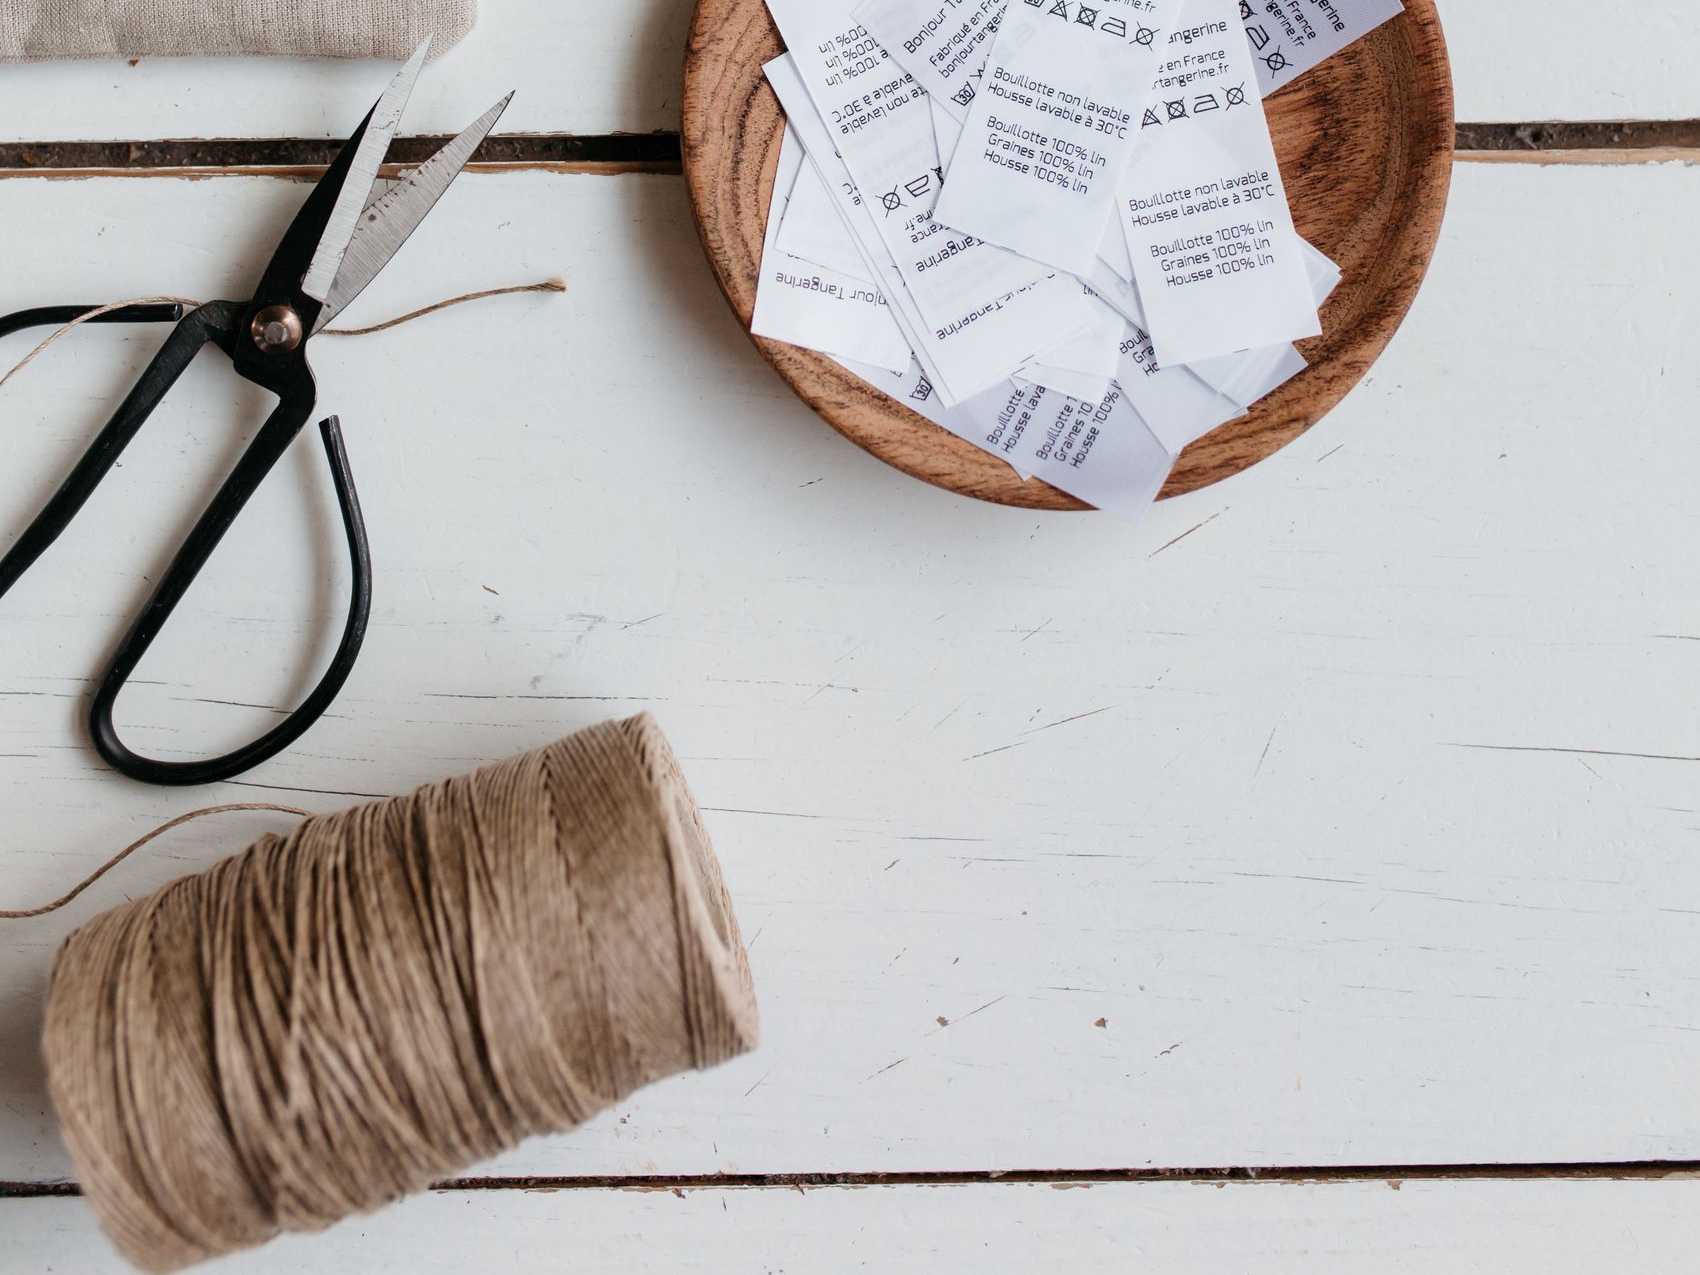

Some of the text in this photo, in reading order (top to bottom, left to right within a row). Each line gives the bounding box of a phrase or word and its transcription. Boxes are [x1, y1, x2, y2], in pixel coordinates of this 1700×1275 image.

[819, 25, 867, 53] 00% lin
[903, 8, 947, 53] Bonjour
[929, 23, 972, 67] Fabriqué
[970, 11, 985, 26] en
[1168, 21, 1228, 44] ngerine
[1287, 0, 1316, 40] France
[826, 56, 842, 68] lin
[842, 38, 879, 61] 100%
[939, 5, 1007, 79] bonjourtangeri
[1167, 60, 1181, 71] en
[1184, 50, 1225, 66] France
[826, 56, 880, 86] 100% lin
[873, 73, 914, 99] avable
[1152, 62, 1229, 90] rtangerine.fr
[832, 100, 862, 123] 30°C
[840, 94, 909, 134] non lavable
[863, 95, 872, 106] à
[988, 82, 1127, 139] Housse lavable à 30°C
[994, 67, 1130, 124] Bouillotte non lavable
[987, 116, 1106, 167] Bouillotte 100% lin
[988, 134, 1094, 179] Graines 100% lin
[984, 149, 1088, 194] Housse 100% lin
[1129, 171, 1269, 211] Bouillotte non lavable
[1132, 185, 1275, 227] Housse lavable à 30°C
[911, 224, 950, 243] rance
[1150, 220, 1274, 257] Bouillotte 100% lin
[1161, 238, 1271, 272] Graines 100% lin
[1166, 254, 1274, 287] Housse 100% lin
[776, 272, 888, 307] njour Tangerine
[1119, 329, 1148, 354] Bouil
[987, 389, 1024, 445] Bouillotte
[1002, 385, 1046, 453] Housse lava
[1036, 404, 1073, 460] Bouillotte
[1054, 419, 1084, 462] Graines
[1078, 402, 1093, 417] 10
[1069, 427, 1100, 468] Housse
[1093, 392, 1119, 425] 100%
